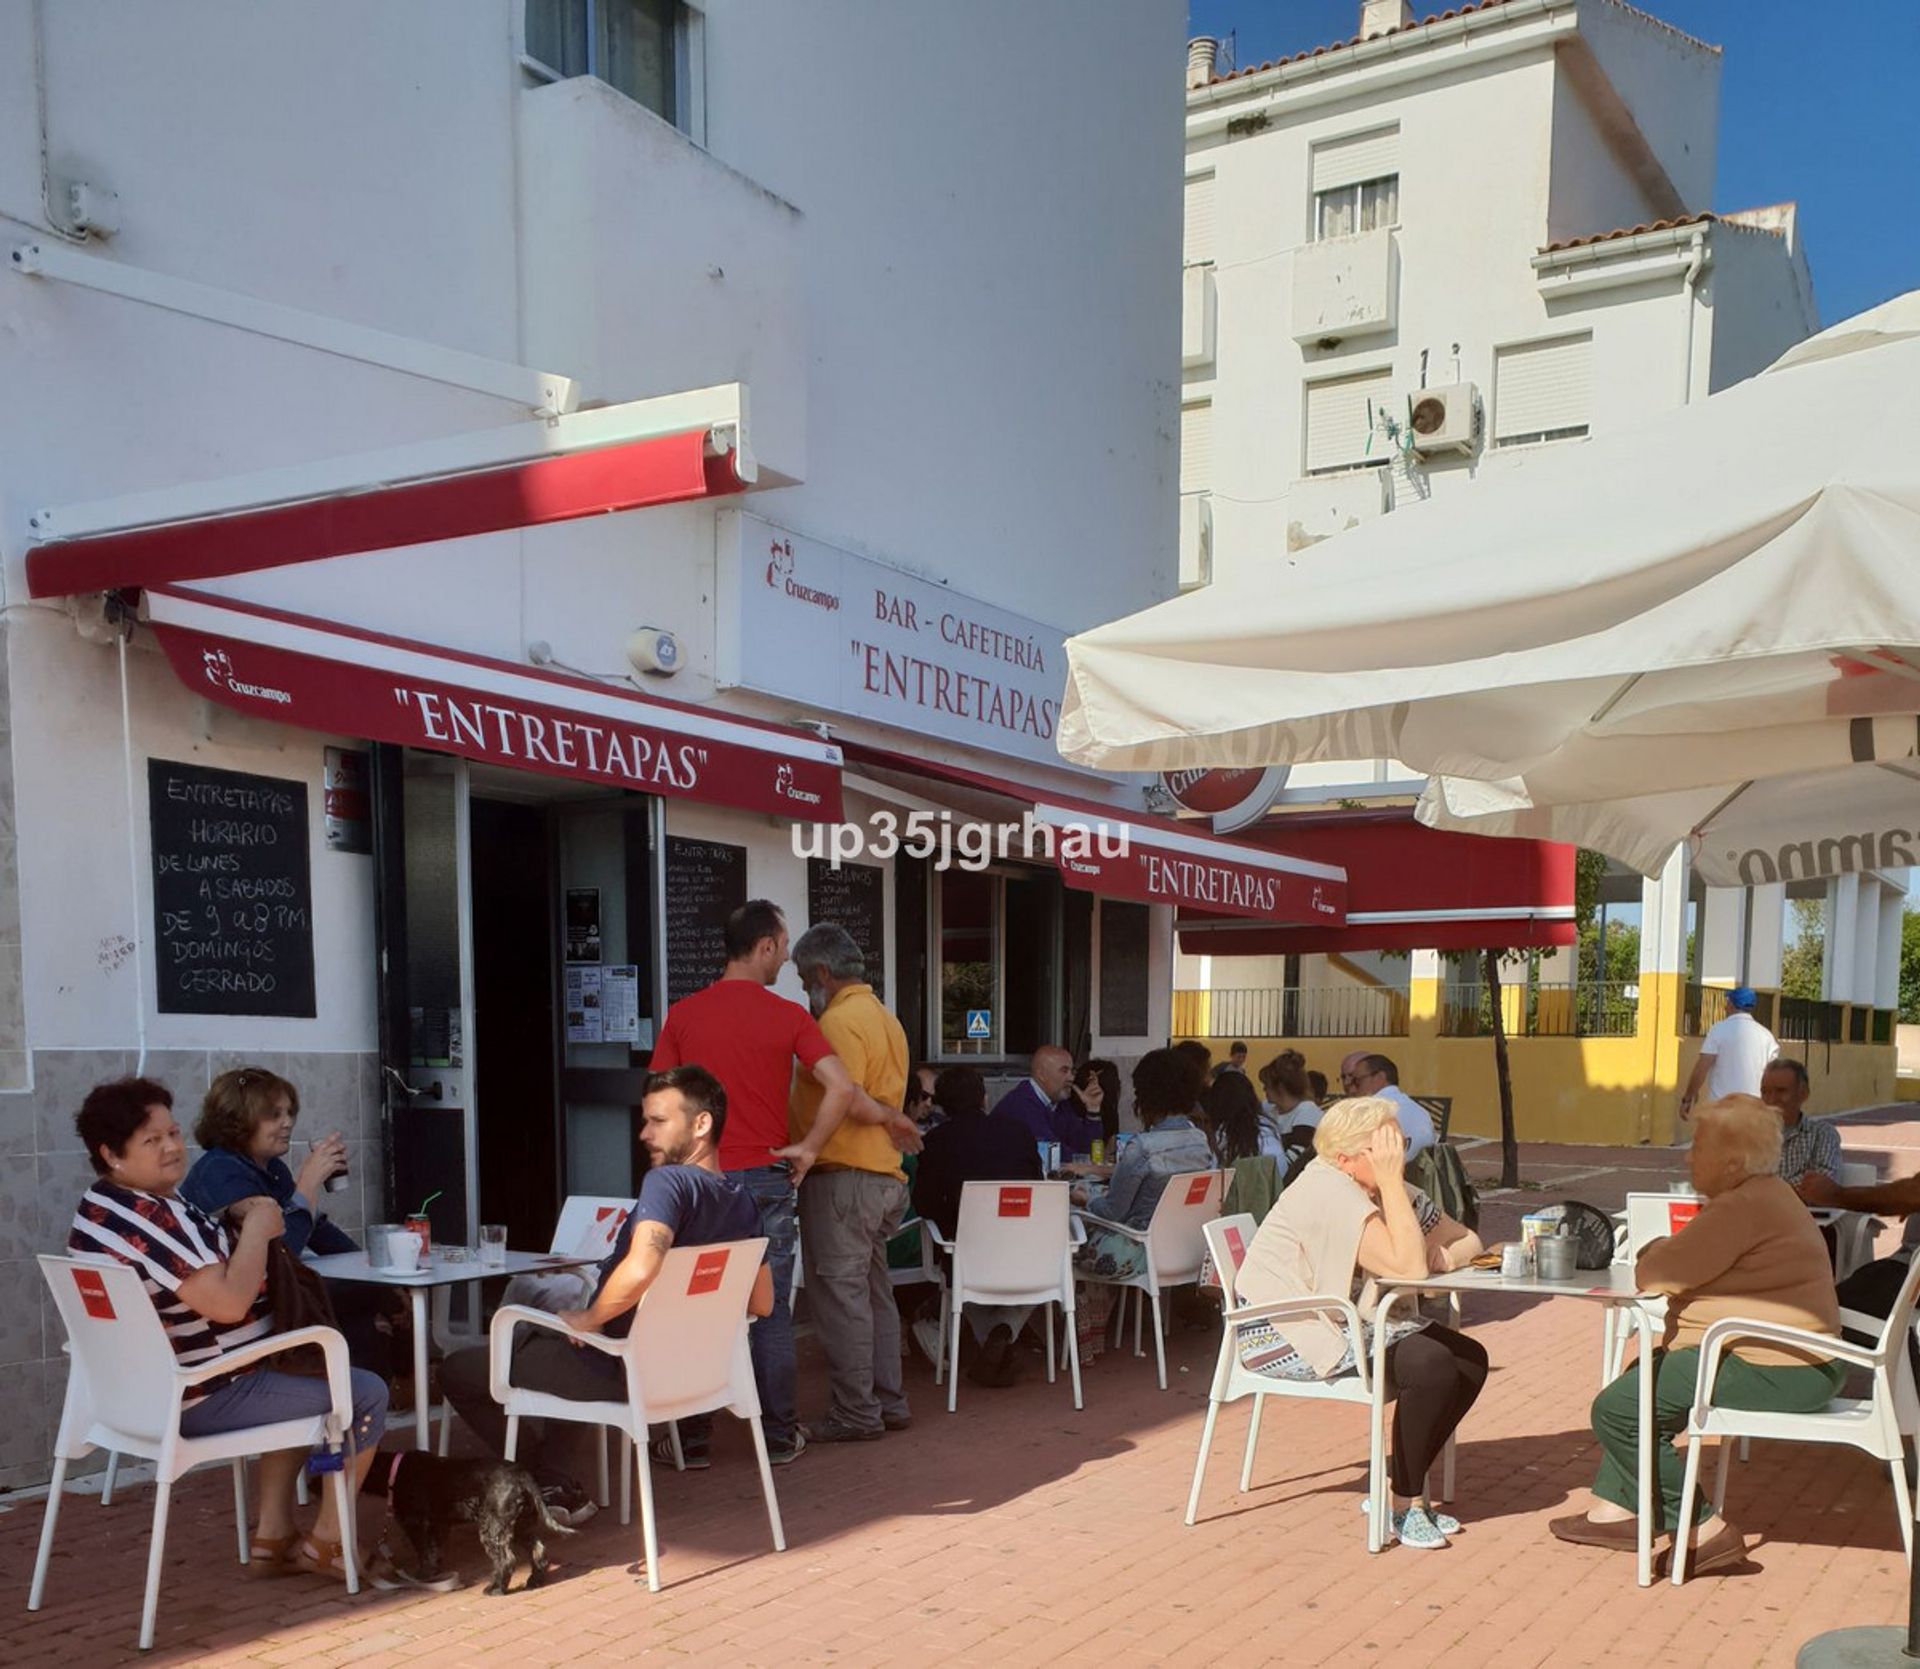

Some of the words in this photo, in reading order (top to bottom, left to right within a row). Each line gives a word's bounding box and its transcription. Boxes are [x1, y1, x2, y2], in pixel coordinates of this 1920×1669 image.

[785, 578, 839, 610] Cruzcampo
[875, 590, 919, 632] BAR
[941, 614, 1045, 673] CAFETERÍA
[228, 678, 291, 703] Cruzcampo
[852, 640, 1062, 740] "ENTRETAPAS"
[394, 688, 707, 789] "ENTRETAPAS"
[168, 778, 294, 814] ENTRETAPAS
[189, 819, 277, 845] HORARIO
[159, 854, 183, 874] DE
[187, 853, 240, 872] LUNES
[200, 878, 211, 899] A
[216, 877, 296, 899] SABADOS
[1140, 854, 1281, 911] "ENTRETAPAS"
[163, 910, 193, 935] DE
[206, 904, 220, 936] 9
[254, 903, 270, 932] 8
[180, 969, 275, 994] CERRADO
